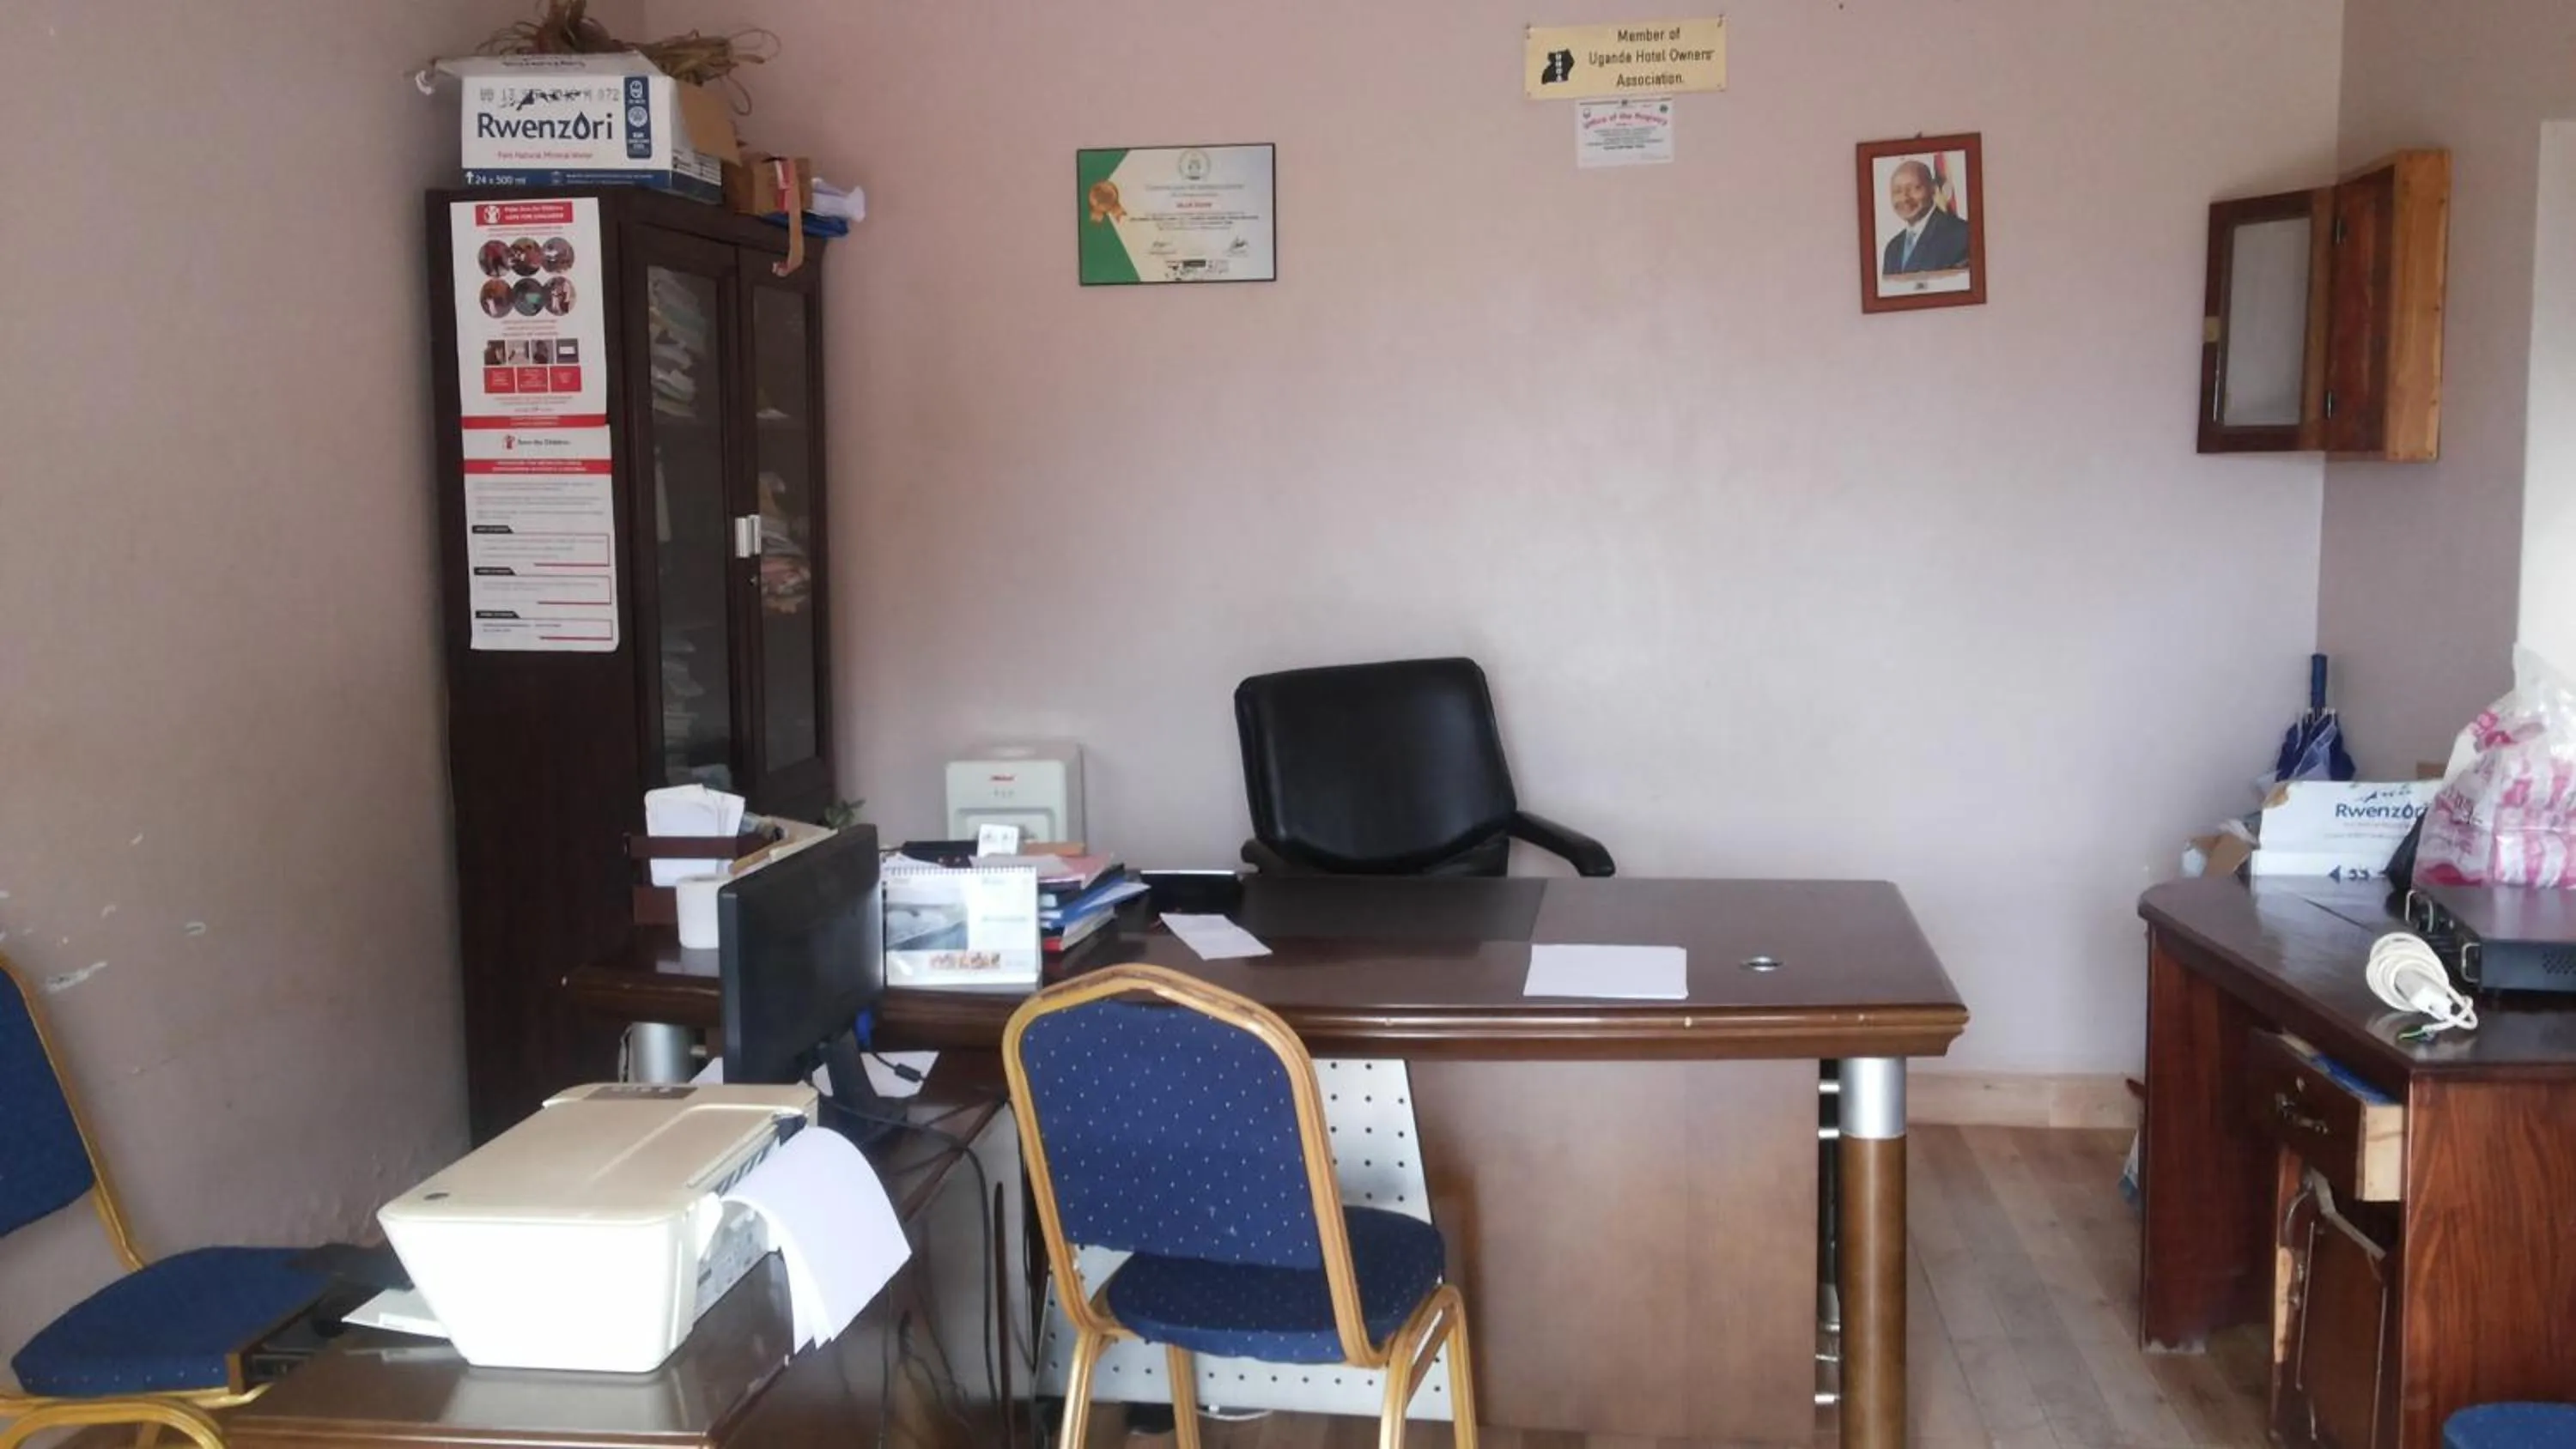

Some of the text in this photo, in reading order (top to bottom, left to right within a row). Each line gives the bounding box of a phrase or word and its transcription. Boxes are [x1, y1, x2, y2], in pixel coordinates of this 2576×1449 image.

[1617, 27, 1680, 42] Member of
[1635, 49, 1665, 63] Hotel
[477, 112, 613, 140] Rwenzori
[474, 175, 487, 185] 24
[495, 175, 513, 185] 500
[2335, 800, 2428, 819] Rwenzor
